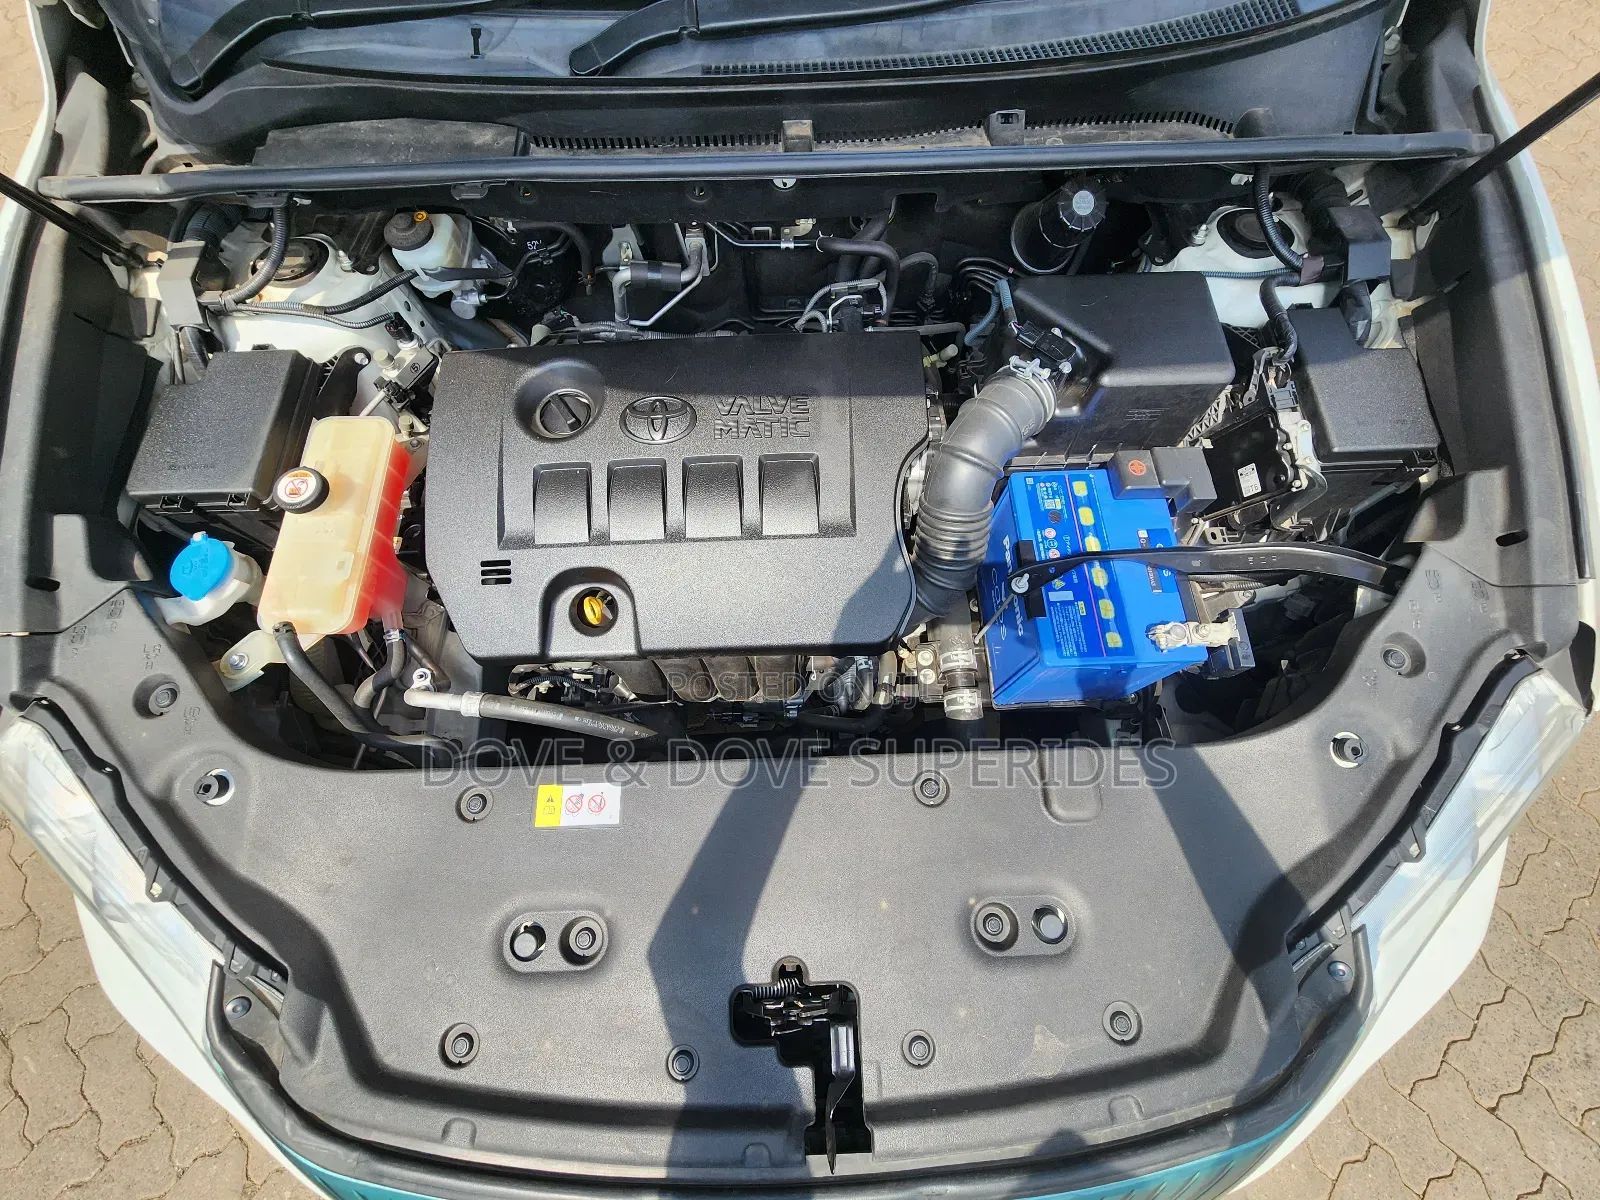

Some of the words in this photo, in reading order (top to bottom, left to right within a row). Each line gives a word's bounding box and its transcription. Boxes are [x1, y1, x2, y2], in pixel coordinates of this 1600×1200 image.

[714, 395, 809, 416] VALVE
[714, 417, 810, 439] MATIC
[1002, 534, 1024, 637] Panonic
